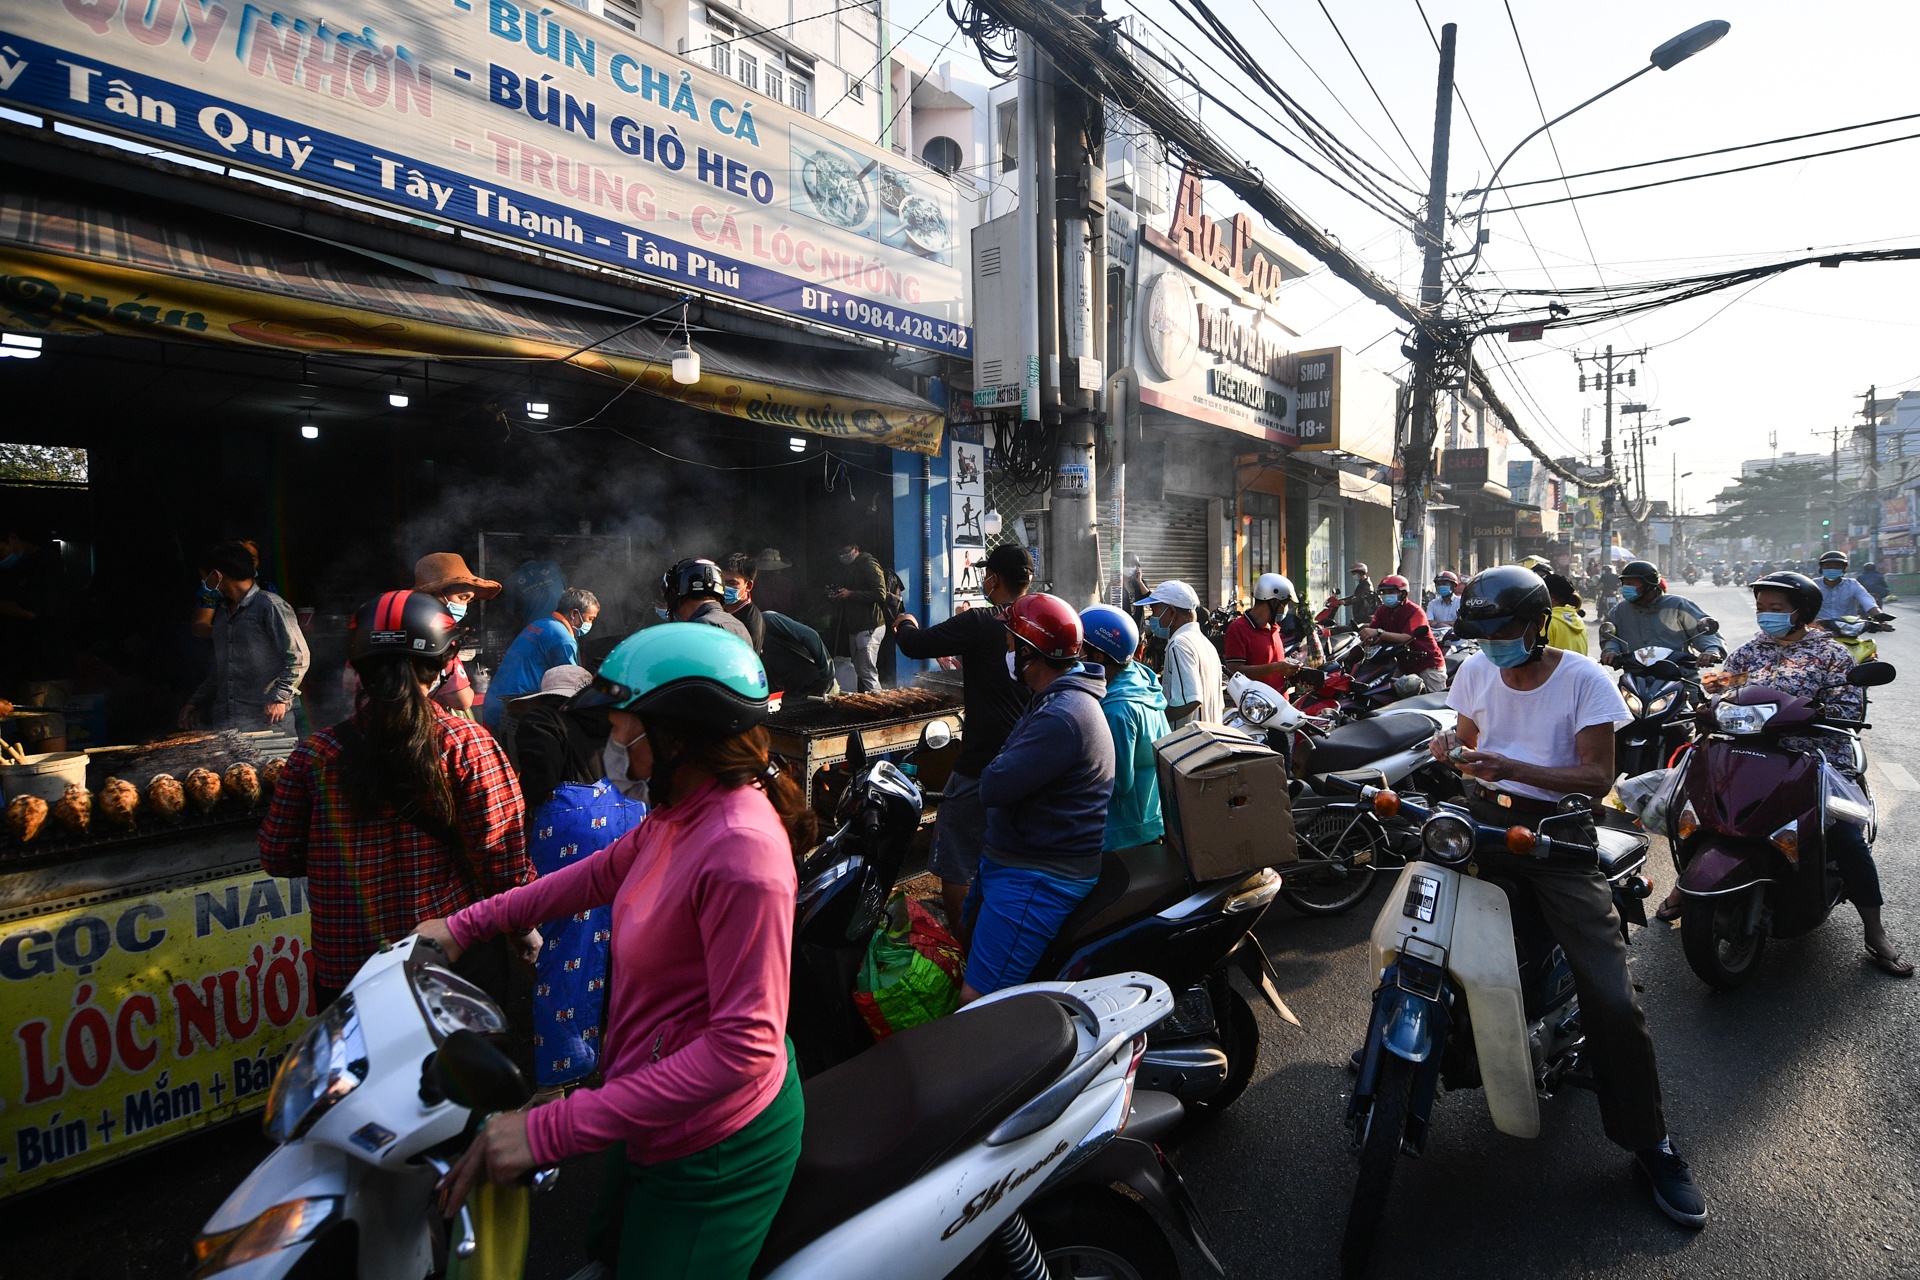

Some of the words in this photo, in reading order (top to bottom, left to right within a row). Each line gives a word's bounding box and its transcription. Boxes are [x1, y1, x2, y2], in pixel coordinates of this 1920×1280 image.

[489, 0, 596, 78] BÚN
[609, 52, 700, 123] CHẢ
[709, 99, 761, 148] CÁ
[489, 62, 596, 142] BÚN
[609, 114, 686, 171] GIÒ
[697, 146, 774, 205] HEO
[56, 58, 177, 129] Tân
[198, 106, 314, 171] Quý
[372, 155, 454, 211] Tây
[469, 184, 584, 245] Thạnh
[621, 231, 679, 272] Tân
[687, 250, 741, 290] Phú
[486, 130, 657, 222] TRUNG
[691, 200, 743, 252] CÁ
[752, 224, 818, 273] LÓC
[820, 247, 921, 305] NƯỚNG
[0, 275, 209, 333] Quán
[801, 286, 839, 317] ĐT:
[844, 299, 969, 350] 0984.428.542
[1208, 369, 1266, 411] VEGETARIAN
[1266, 390, 1288, 418] FOOD
[1296, 392, 1317, 411] SINH
[1320, 388, 1331, 410] LÝ
[1301, 362, 1326, 382] SHOP
[745, 393, 802, 428] BÌNH
[806, 403, 850, 435] DÂN
[1299, 420, 1326, 438] 18+
[1731, 749, 1767, 759] HONDA
[18, 984, 158, 1104] LÓC
[17, 1111, 88, 1174] Bún
[124, 1070, 203, 1136] Mắm
